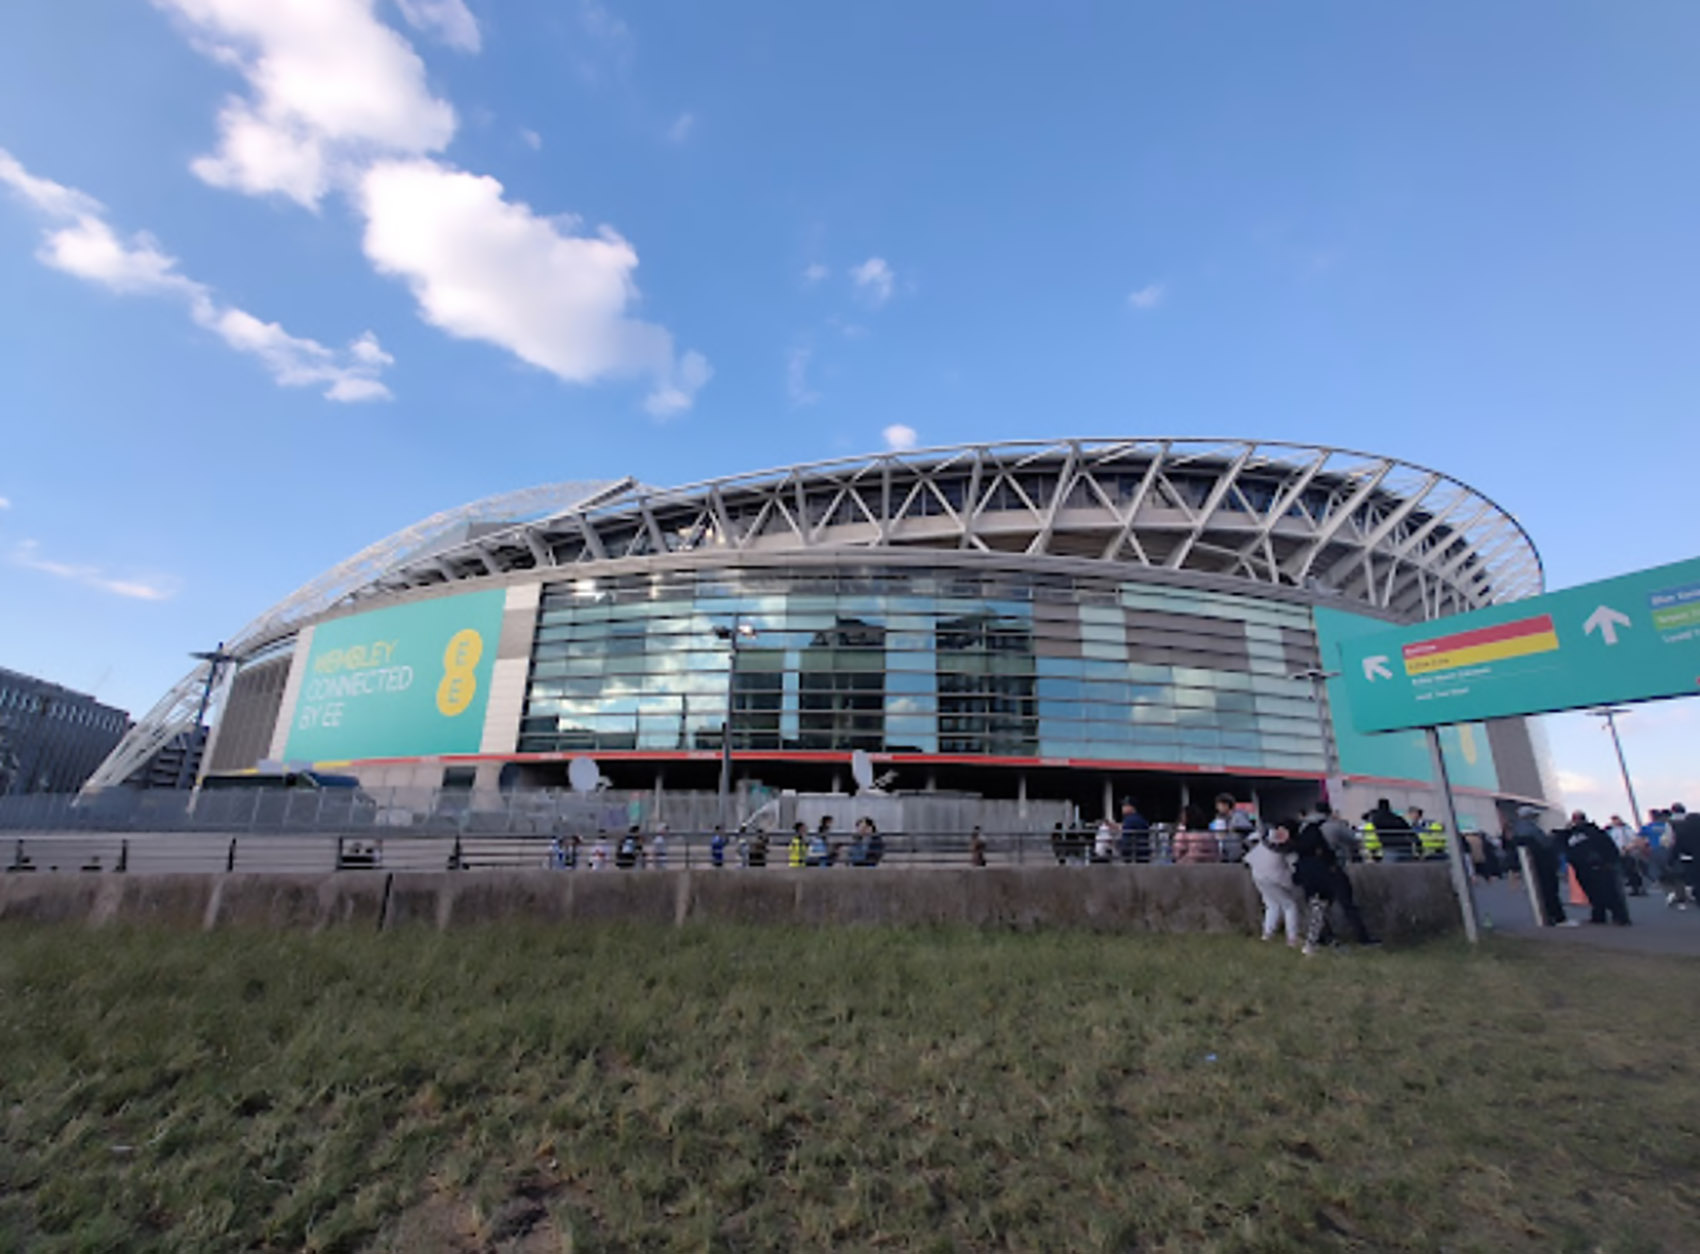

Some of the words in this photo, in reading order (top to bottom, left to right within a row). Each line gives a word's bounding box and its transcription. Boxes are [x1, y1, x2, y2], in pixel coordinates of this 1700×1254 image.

[314, 639, 399, 672] WEMBLEY
[307, 666, 413, 700] CONNECTED
[298, 705, 319, 730] BY
[322, 702, 344, 727] EE
